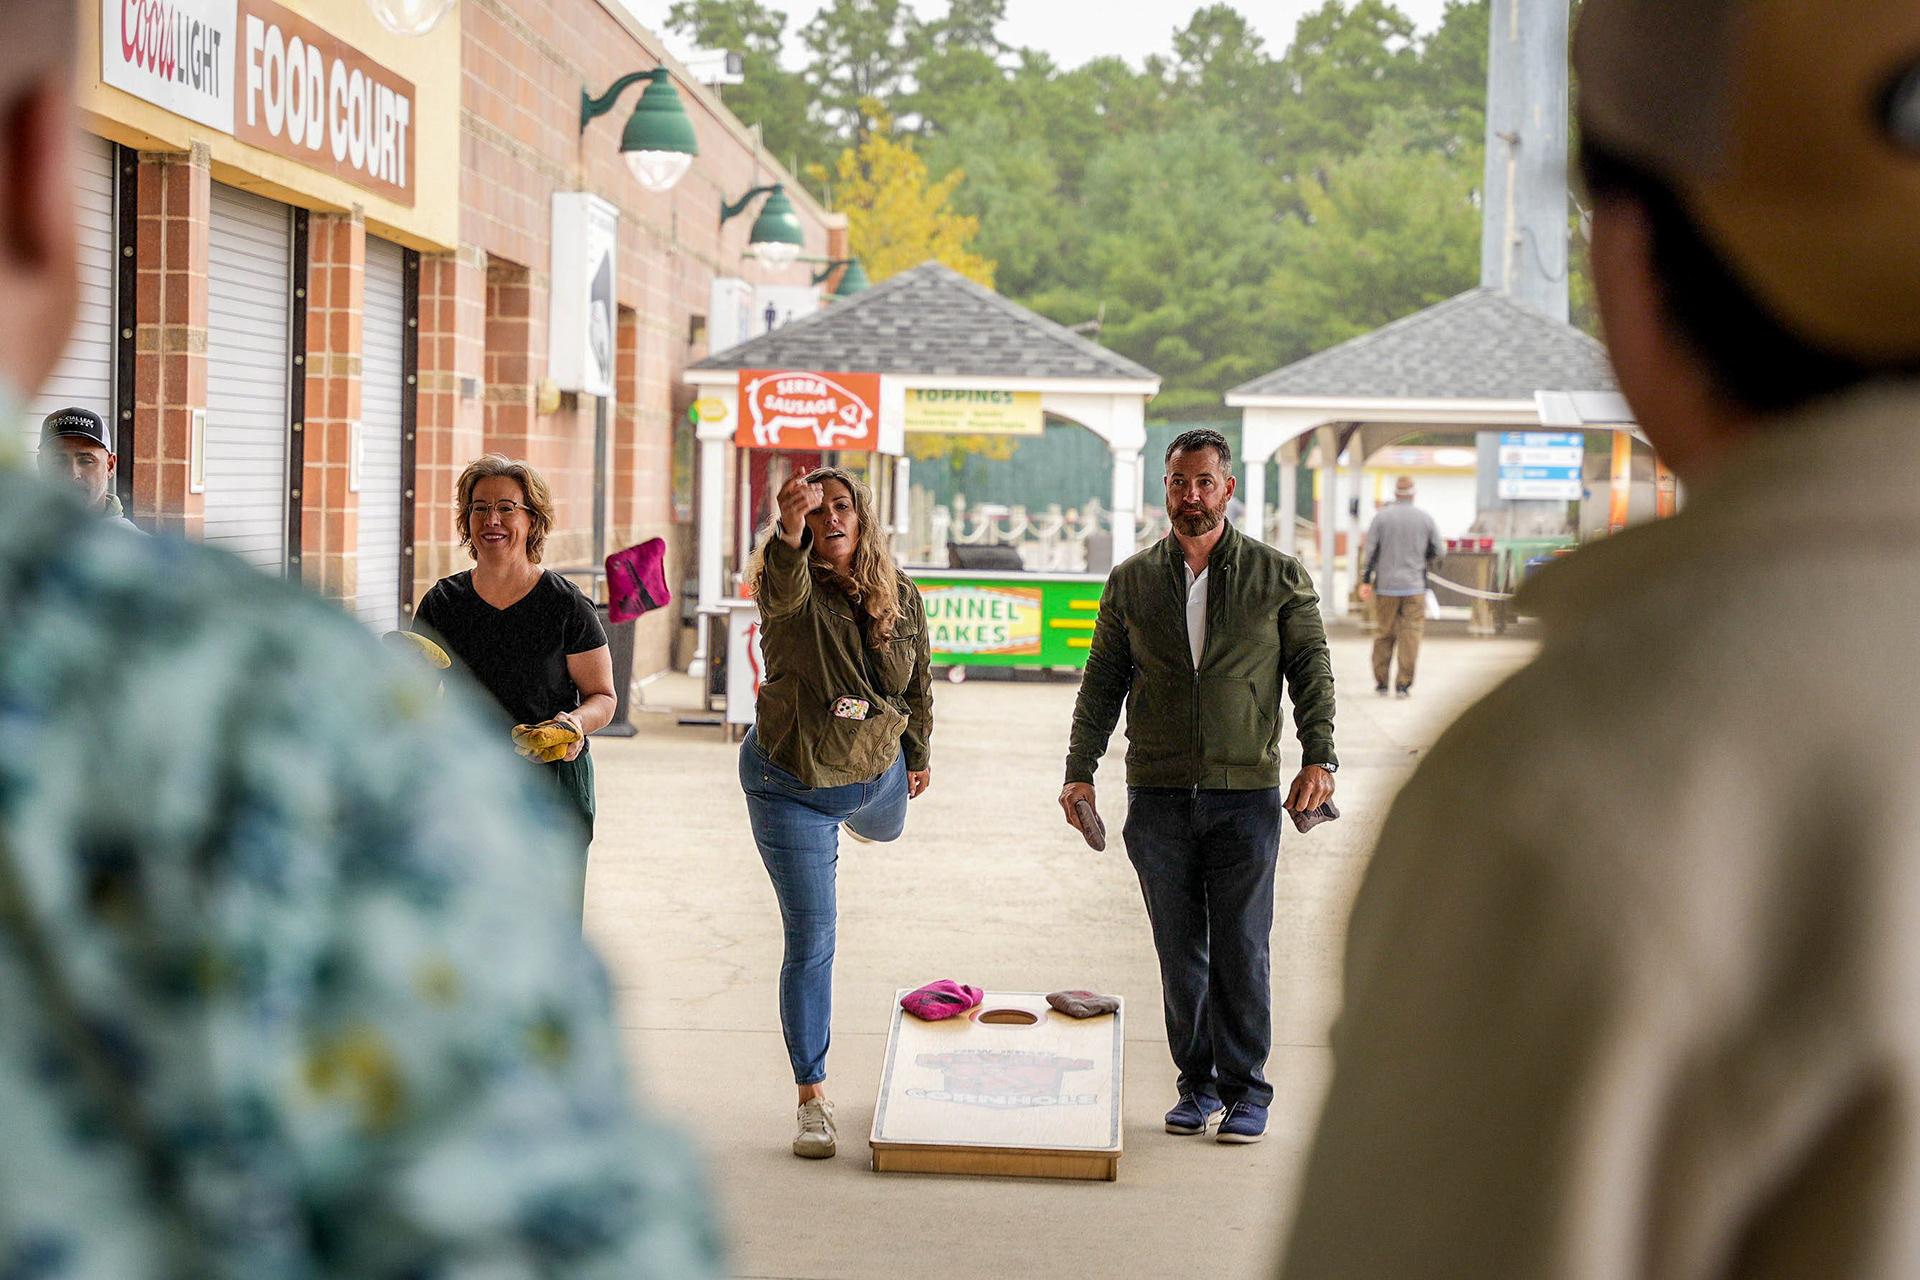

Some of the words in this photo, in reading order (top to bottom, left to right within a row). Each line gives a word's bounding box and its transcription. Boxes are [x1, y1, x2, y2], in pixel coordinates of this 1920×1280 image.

[121, 0, 175, 82] Coors
[177, 11, 221, 99] LIGHT
[246, 13, 324, 151] FOOD
[329, 58, 409, 189] COURT
[776, 379, 827, 396] SERRA
[915, 389, 1013, 404] TOPPINGS
[763, 394, 837, 415] SAUSAGE
[925, 599, 1018, 619] UNNEL
[927, 625, 1006, 643] AKES
[905, 1088, 1098, 1106] CORNHOLE
